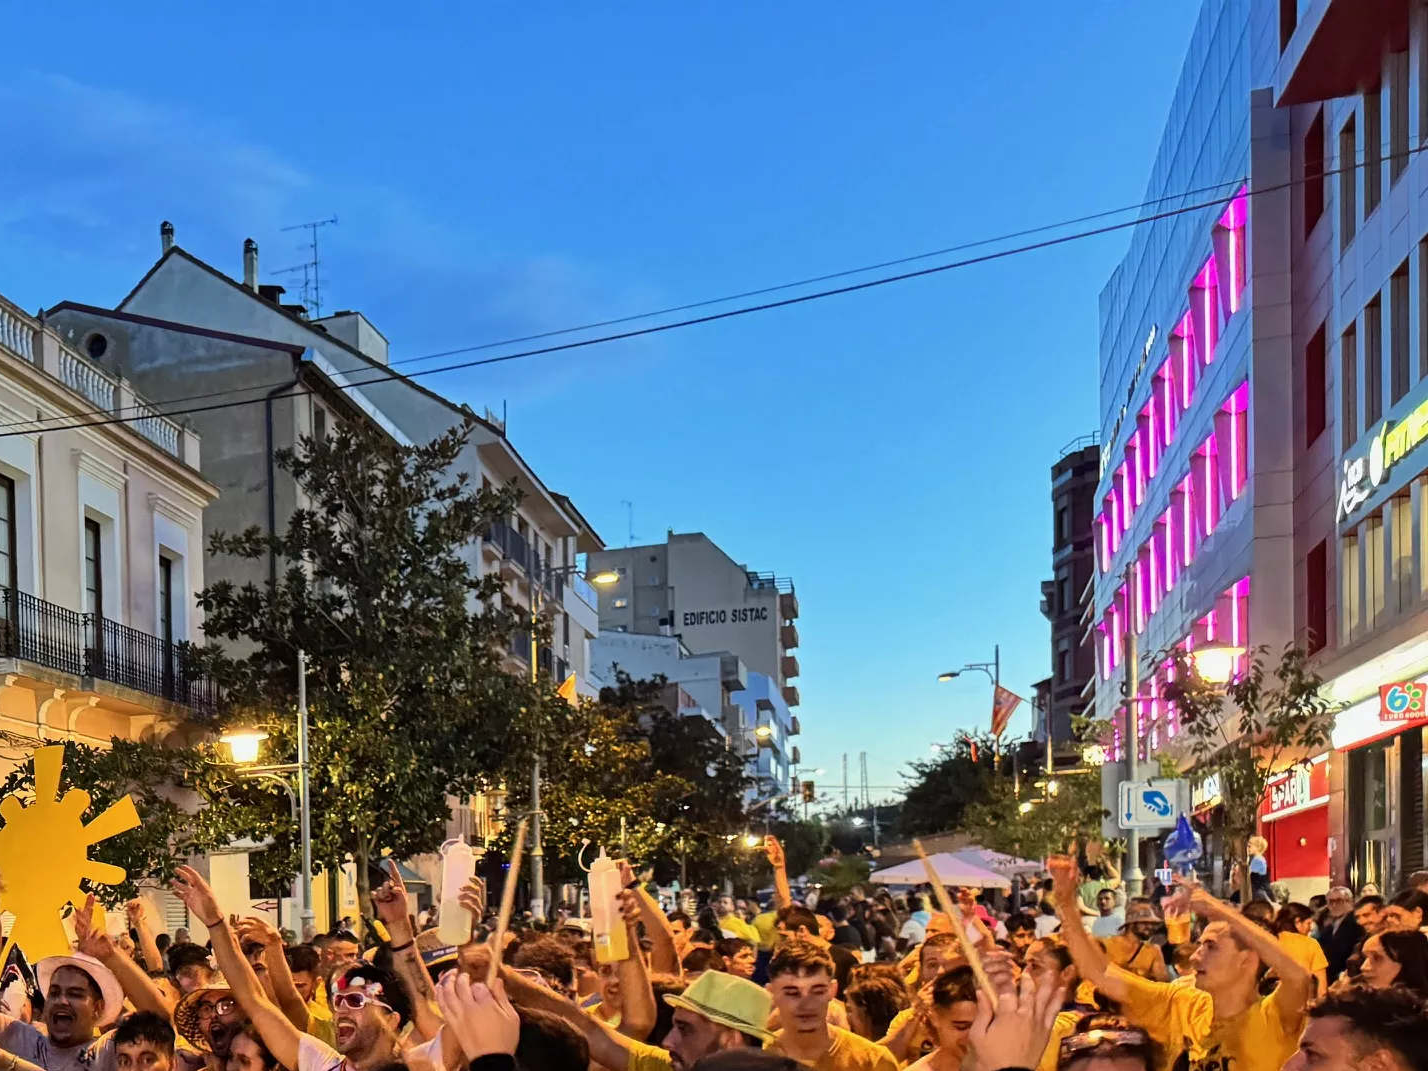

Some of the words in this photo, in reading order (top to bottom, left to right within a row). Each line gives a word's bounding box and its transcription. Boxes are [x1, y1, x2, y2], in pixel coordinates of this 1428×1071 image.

[683, 610, 727, 627] EDIFICIO
[731, 606, 768, 623] SISTAC
[1271, 778, 1298, 811] SPAR
